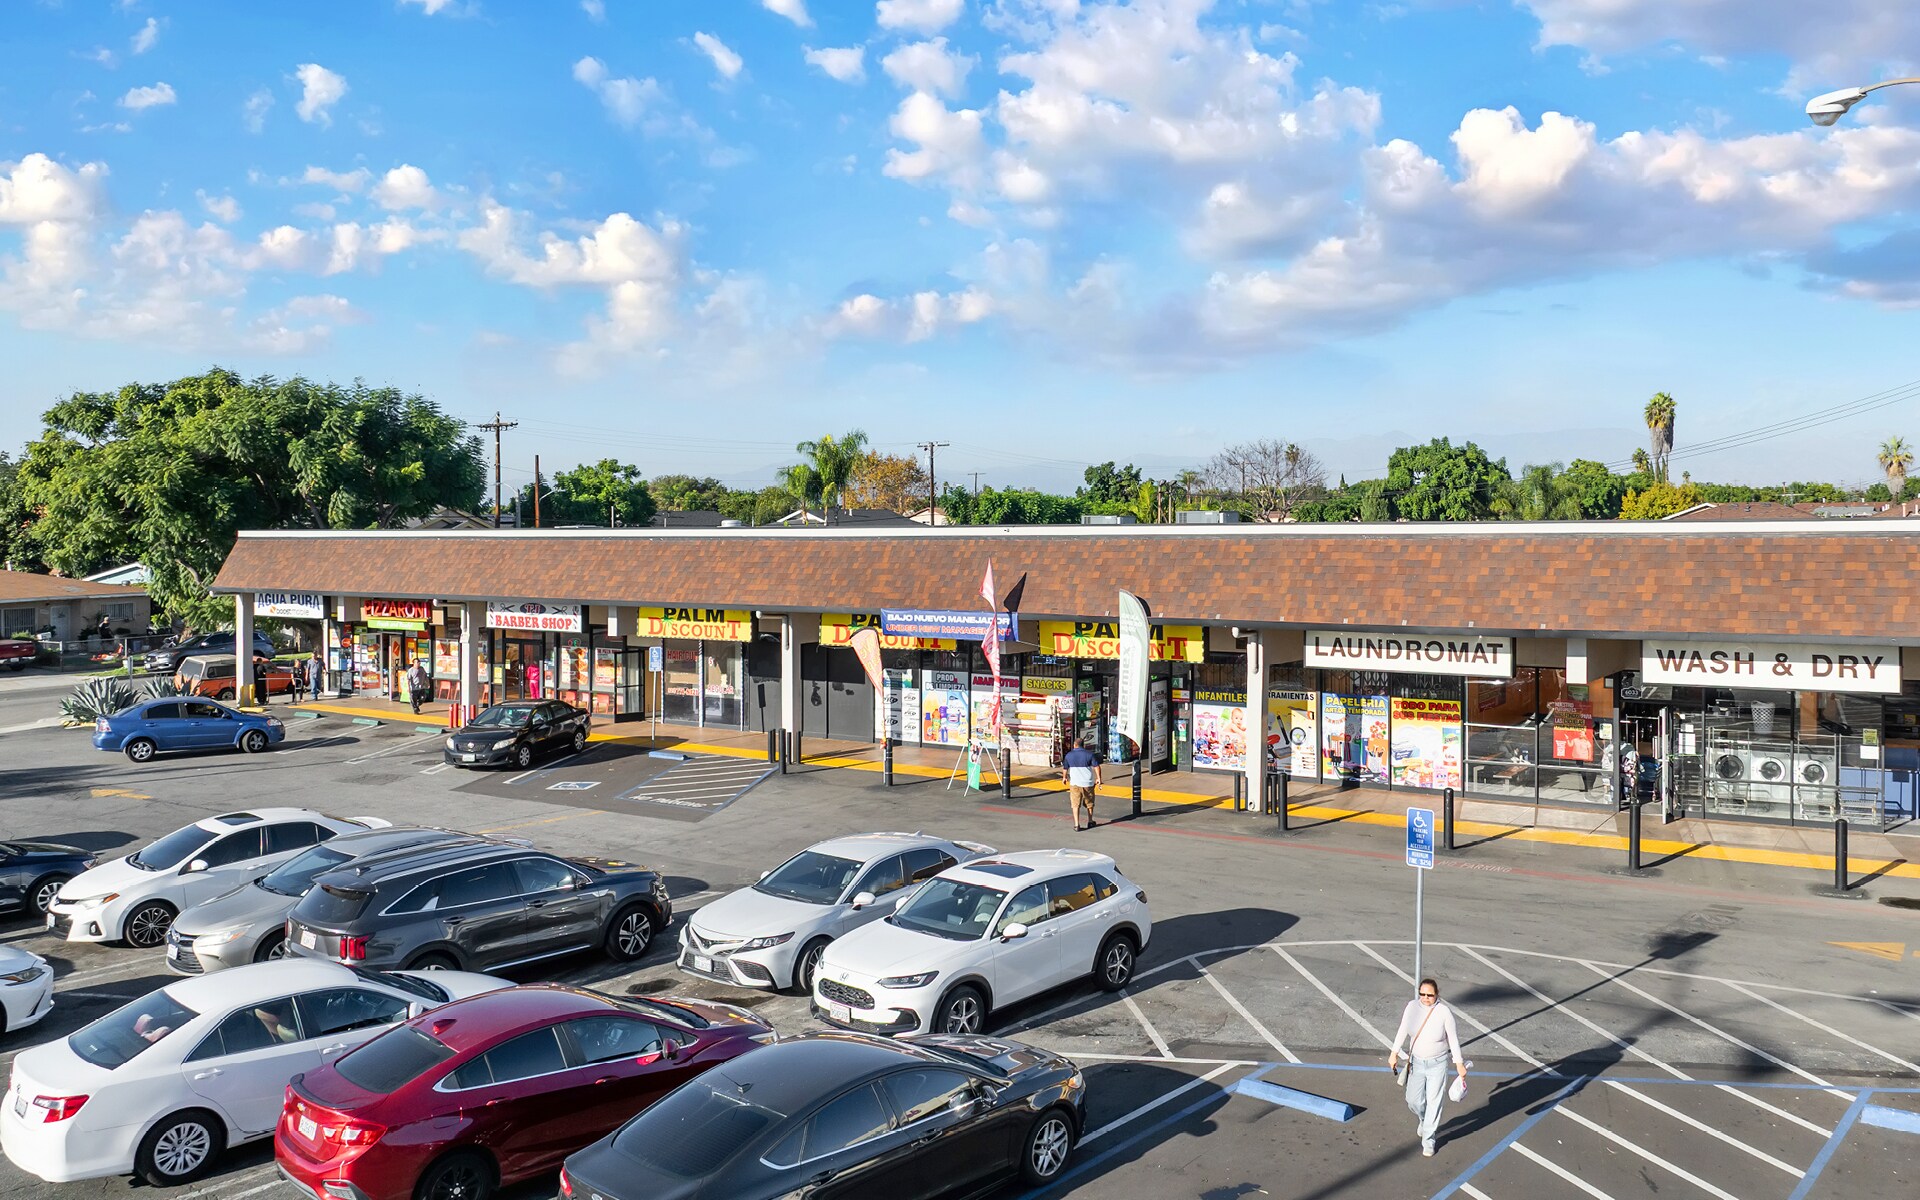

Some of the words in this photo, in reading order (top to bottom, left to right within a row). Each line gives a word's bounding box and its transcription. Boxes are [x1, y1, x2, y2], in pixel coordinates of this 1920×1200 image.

[258, 593, 286, 608] AGUA
[290, 594, 320, 610] PURA
[364, 601, 427, 618] PIZZARONI
[663, 607, 725, 623] PALM
[495, 615, 539, 629] BARBER
[541, 617, 572, 630] SHOP
[950, 616, 1010, 625] MANEJADOR
[647, 616, 741, 639] DISCOUNT
[885, 624, 918, 632] UNDER
[1053, 632, 1188, 660] DISCNT
[1315, 636, 1503, 664] LAUNDROMAT
[1656, 649, 1754, 674] WASH
[1772, 653, 1794, 676] &
[1812, 654, 1884, 679] DRY
[925, 682, 935, 690] DE
[1026, 679, 1067, 690] SNACKS
[1195, 691, 1247, 703] INFANTILES
[1326, 697, 1386, 709] PAPELERIA
[1348, 708, 1387, 716] TEMPORADA
[1394, 701, 1426, 710] TODO
[1429, 702, 1460, 712] PARA
[1393, 711, 1415, 720] SUS
[1417, 713, 1461, 723] FIESTAS
[1413, 827, 1428, 835] PARKING
[1460, 862, 1512, 873] PARKING
